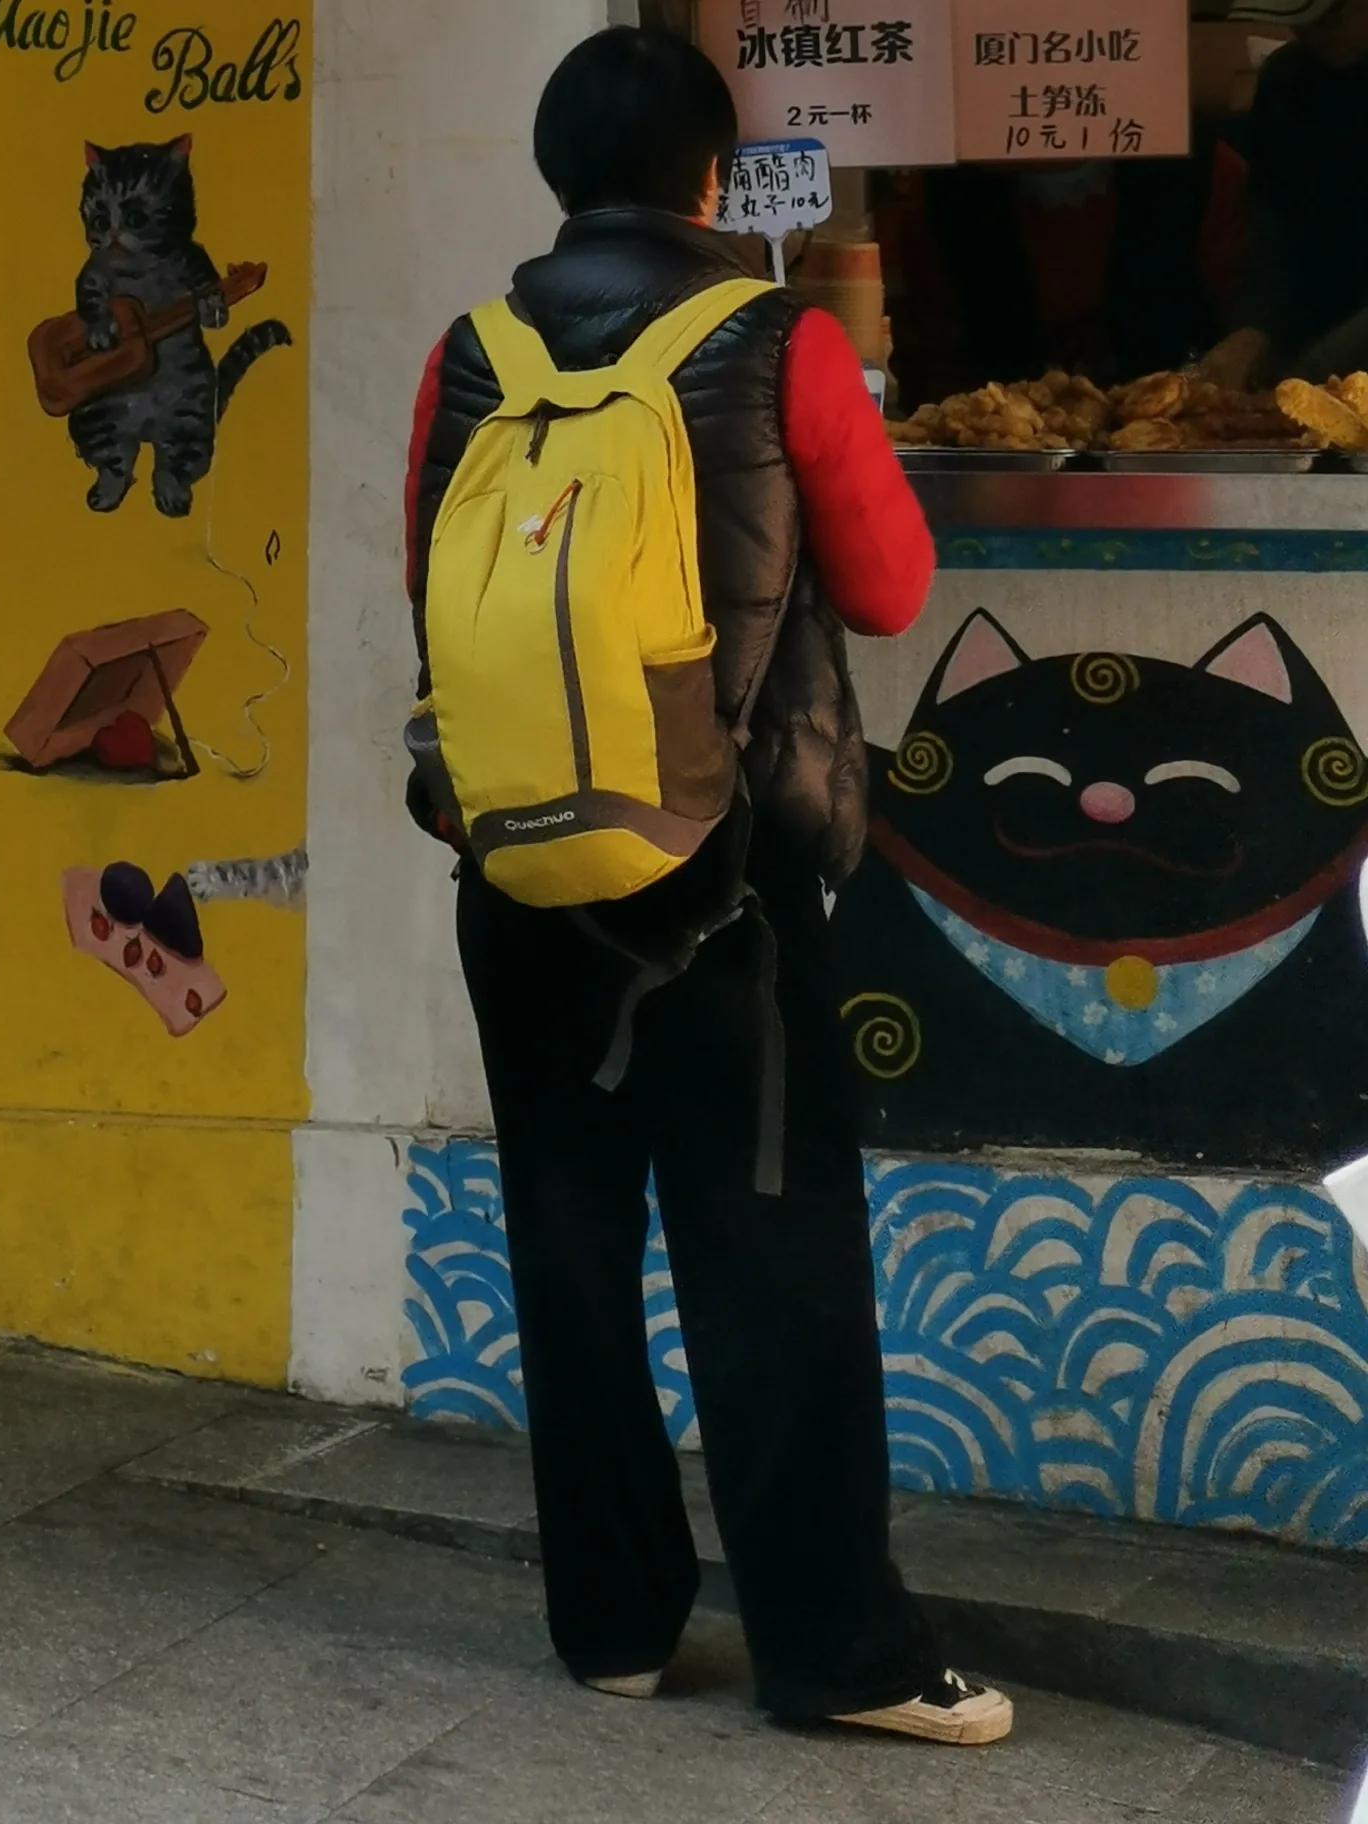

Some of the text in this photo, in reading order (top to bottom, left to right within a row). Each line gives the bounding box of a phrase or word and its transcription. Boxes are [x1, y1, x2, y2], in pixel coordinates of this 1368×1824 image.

[737, 20, 914, 70] 冰镇红茶
[975, 29, 1142, 65] 厦门名小吃
[787, 103, 873, 126] 2元一杯
[1009, 85, 1107, 120] 土笋冻
